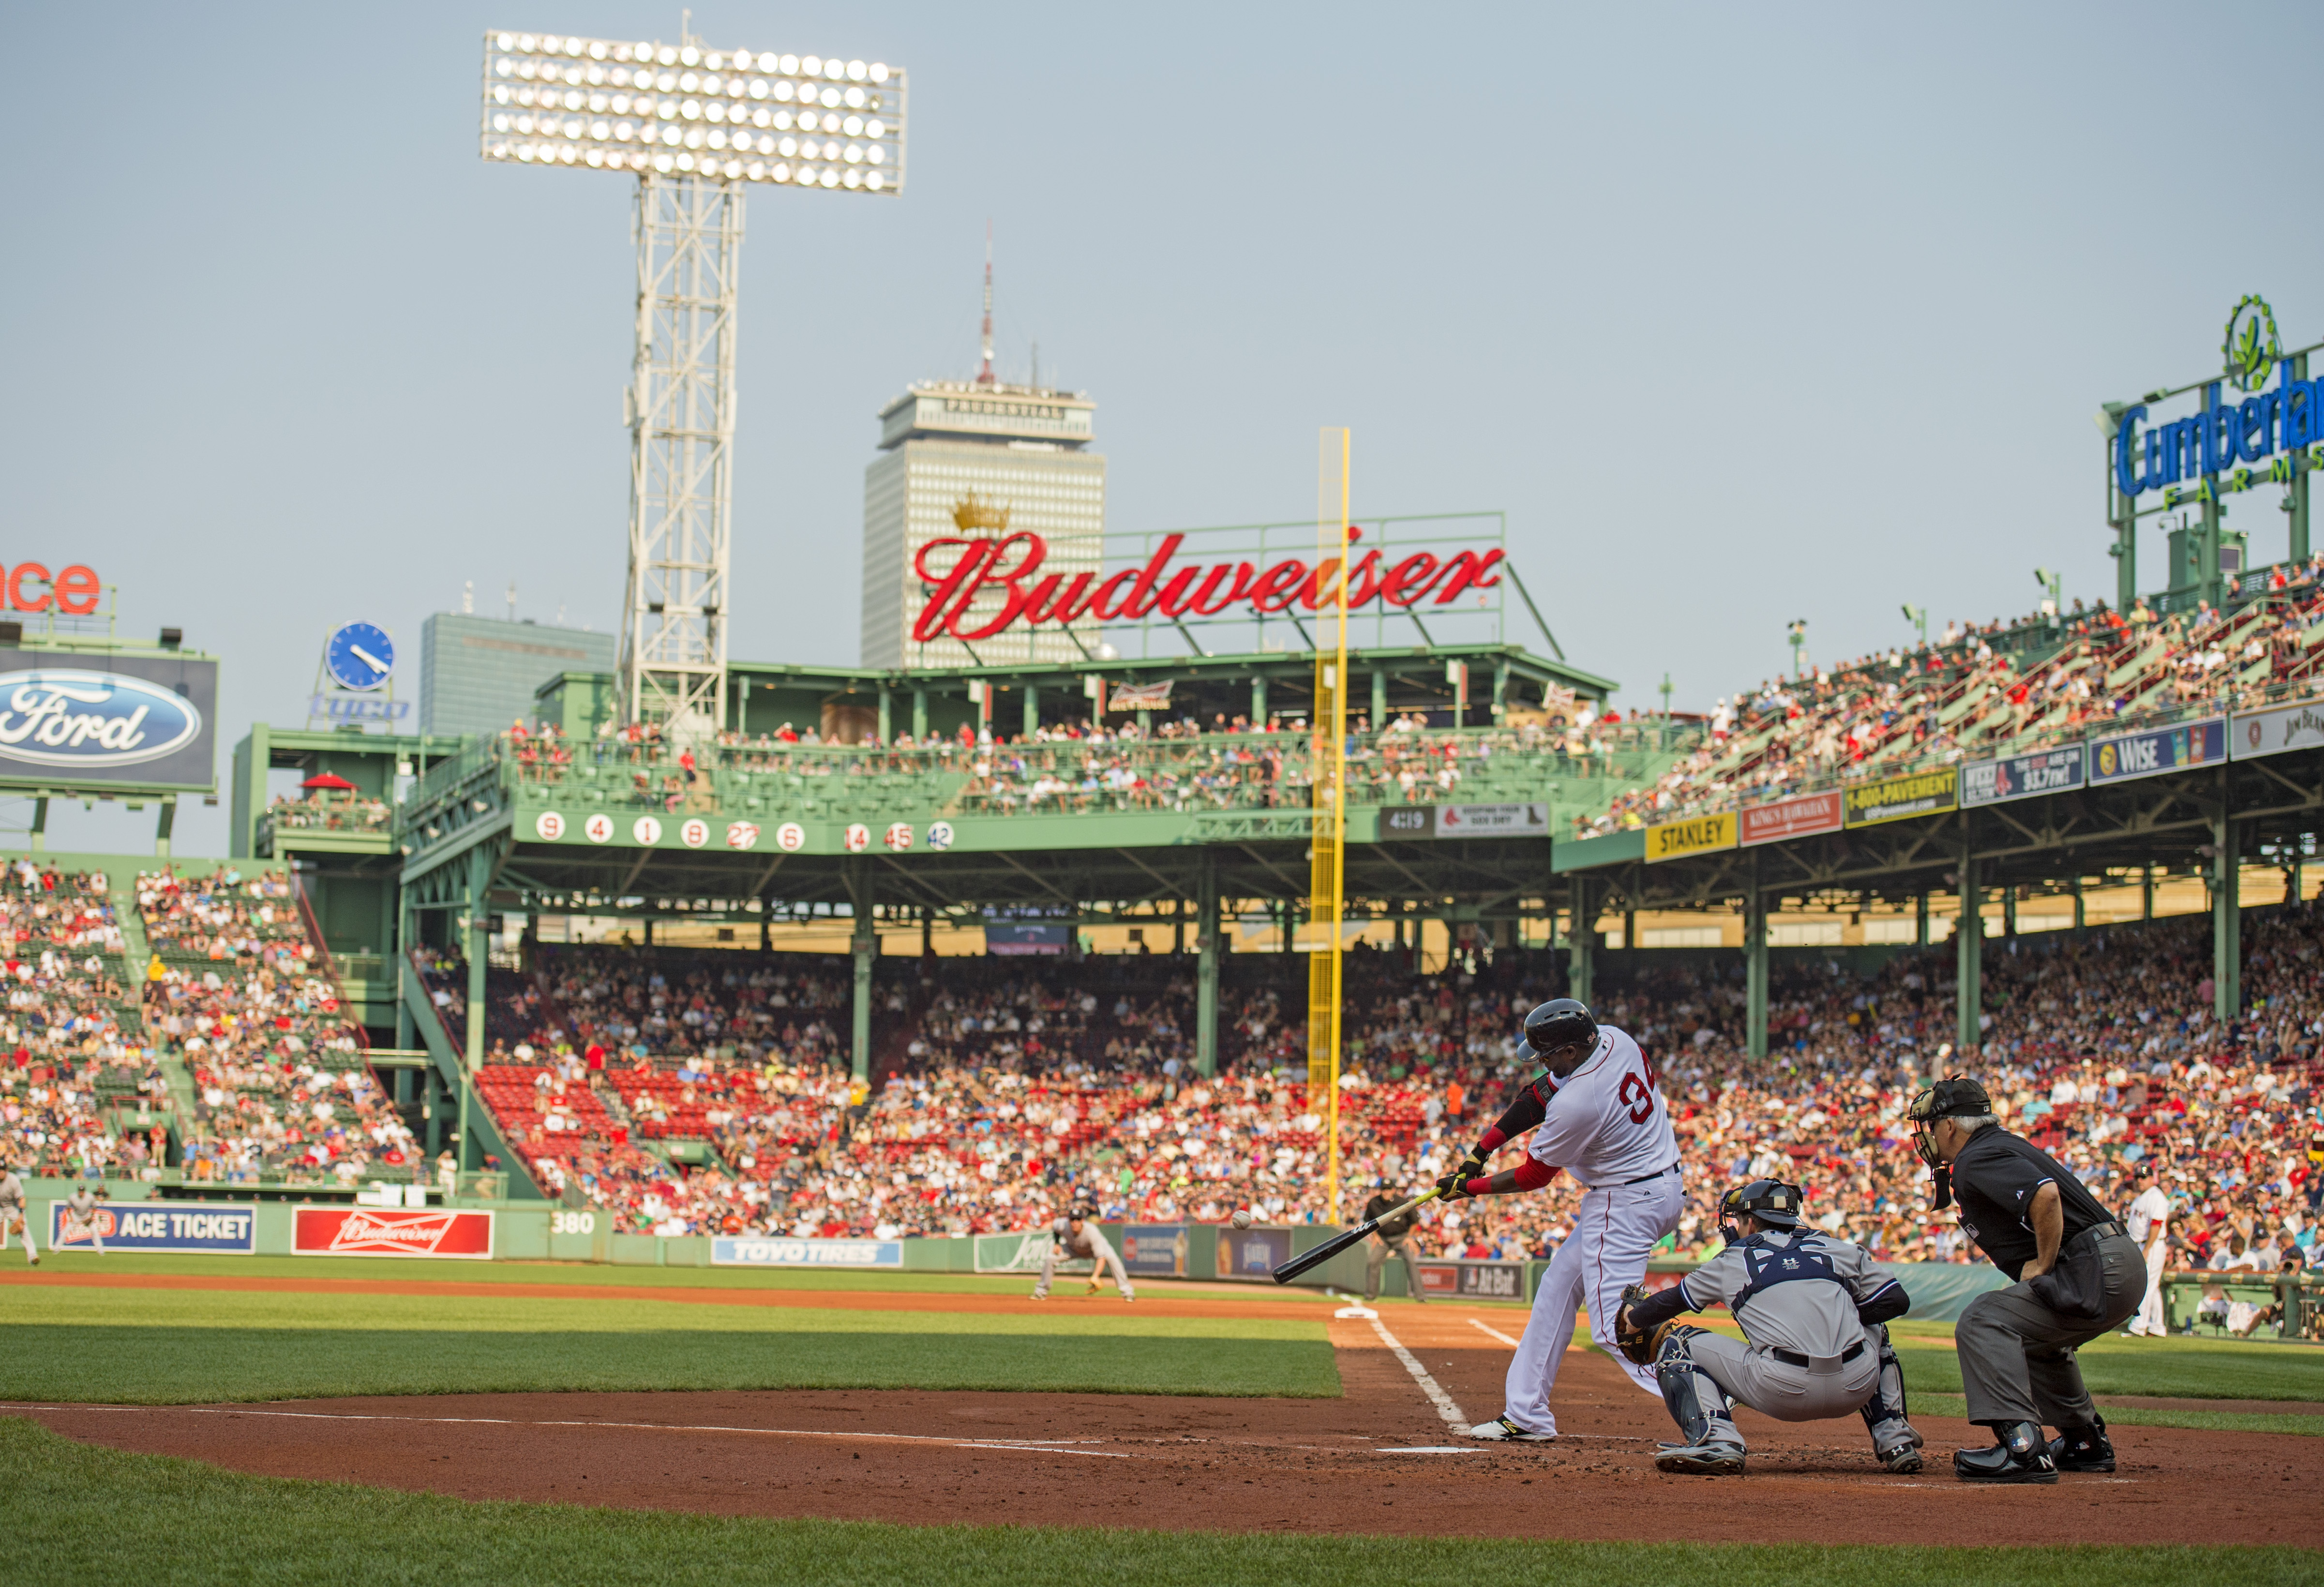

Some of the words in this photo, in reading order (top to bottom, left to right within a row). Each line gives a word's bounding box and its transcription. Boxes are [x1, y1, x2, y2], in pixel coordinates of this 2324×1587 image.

[947, 400, 1063, 419] PRUDENTIAL
[2116, 358, 2324, 497] Cumberla
[0, 562, 100, 615] ce
[913, 525, 1506, 643] Budweiser
[0, 682, 150, 750] Ford
[309, 693, 409, 727] tyco
[2302, 707, 2324, 734] BEA
[2013, 758, 2030, 773] THE
[1846, 772, 1956, 811] 1-800-PAVEMENT
[1389, 809, 1425, 830] 4:19
[544, 818, 558, 836] 9
[592, 820, 604, 838] 4
[645, 822, 651, 841] 1
[688, 824, 702, 843] 8
[727, 824, 761, 847] 27
[784, 828, 798, 847] 6
[844, 827, 866, 850] 14
[884, 824, 914, 848] 45
[926, 827, 949, 847] 42
[1660, 819, 1724, 853] STANLEY
[1587, 1032, 1596, 1044] 34
[120, 1212, 167, 1239] ACE
[169, 1213, 251, 1240] TICKET
[340, 1218, 446, 1241] Budweiser
[550, 1211, 595, 1234] 380
[733, 1242, 807, 1262] TOYO
[807, 1243, 881, 1263] TIRES
[1478, 1266, 1493, 1294] At
[1493, 1266, 1515, 1296] Bat
[2039, 1454, 2054, 1469] N
